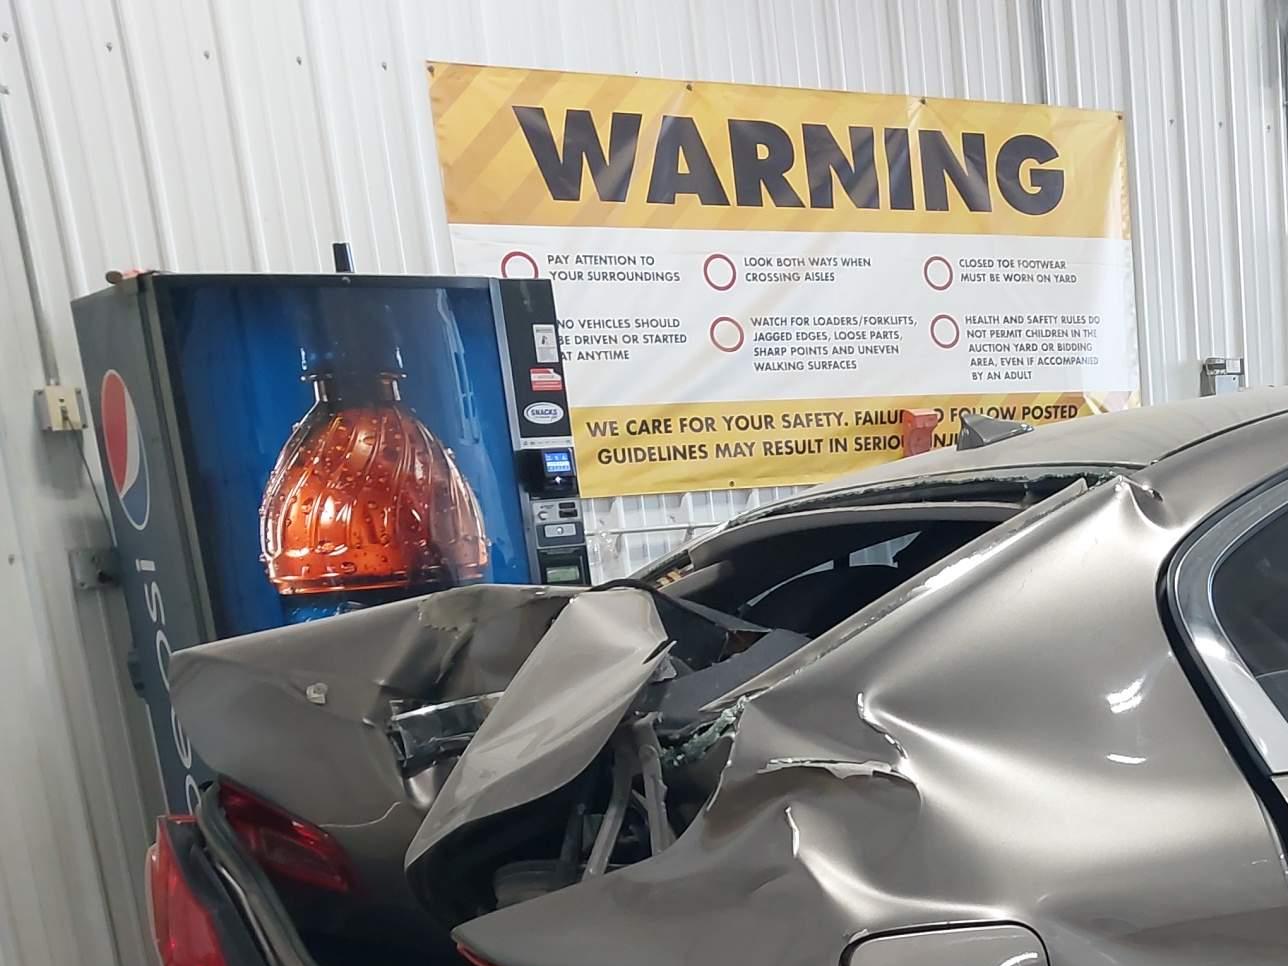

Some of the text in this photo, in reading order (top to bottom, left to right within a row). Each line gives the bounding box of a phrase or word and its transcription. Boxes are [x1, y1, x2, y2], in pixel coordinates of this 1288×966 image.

[511, 105, 1065, 216] WARNING
[547, 254, 655, 266] PAY ATTENTION TO
[744, 257, 871, 267] LOOK BOTH WAYS WHEN
[959, 258, 1066, 269] CLOSED TOE FOOTWEAR
[549, 271, 681, 282] YOUR SURROUNDINGS
[745, 272, 835, 282] CROSSING AISLES
[960, 273, 1077, 283] MUST BE WORN ON YARD
[557, 318, 680, 329] NO VEHICLES SHOULD
[750, 316, 917, 327] WATCH FOR LOADERS/FORKLIFTS,
[965, 315, 1100, 324] HEALTH AND SAFETY RULES DO
[753, 330, 903, 342] JAGGED EDGES, LOOSE PARTS,
[966, 329, 987, 338] NOT
[990, 329, 1022, 338] PERMIT
[1025, 329, 1068, 338] CHILDREN
[1071, 329, 1081, 338] IN
[574, 335, 618, 345] DRIVEN
[622, 334, 639, 344] OR
[643, 334, 687, 344] STARTED
[753, 344, 899, 357] SHARP POINTS AND UNEVEN
[968, 343, 1093, 353] AUCTION YARD OR BIDDING
[560, 350, 630, 361] AT ANYTIME
[753, 360, 857, 372] WALKING SURFACES
[970, 356, 1099, 367] AREA, EVEN IF ACCOMPANIED
[972, 370, 1032, 381] BY AN ADULT
[586, 420, 619, 438] WE
[626, 418, 673, 436] CARE
[679, 416, 717, 433] FOR
[722, 413, 776, 432] YOUR
[781, 411, 849, 429] SAFETY.
[855, 408, 903, 426] FAILU
[1021, 405, 1078, 420] POSTED
[597, 434, 904, 465] GUIDELINES MAY RESULT IN SERIO
